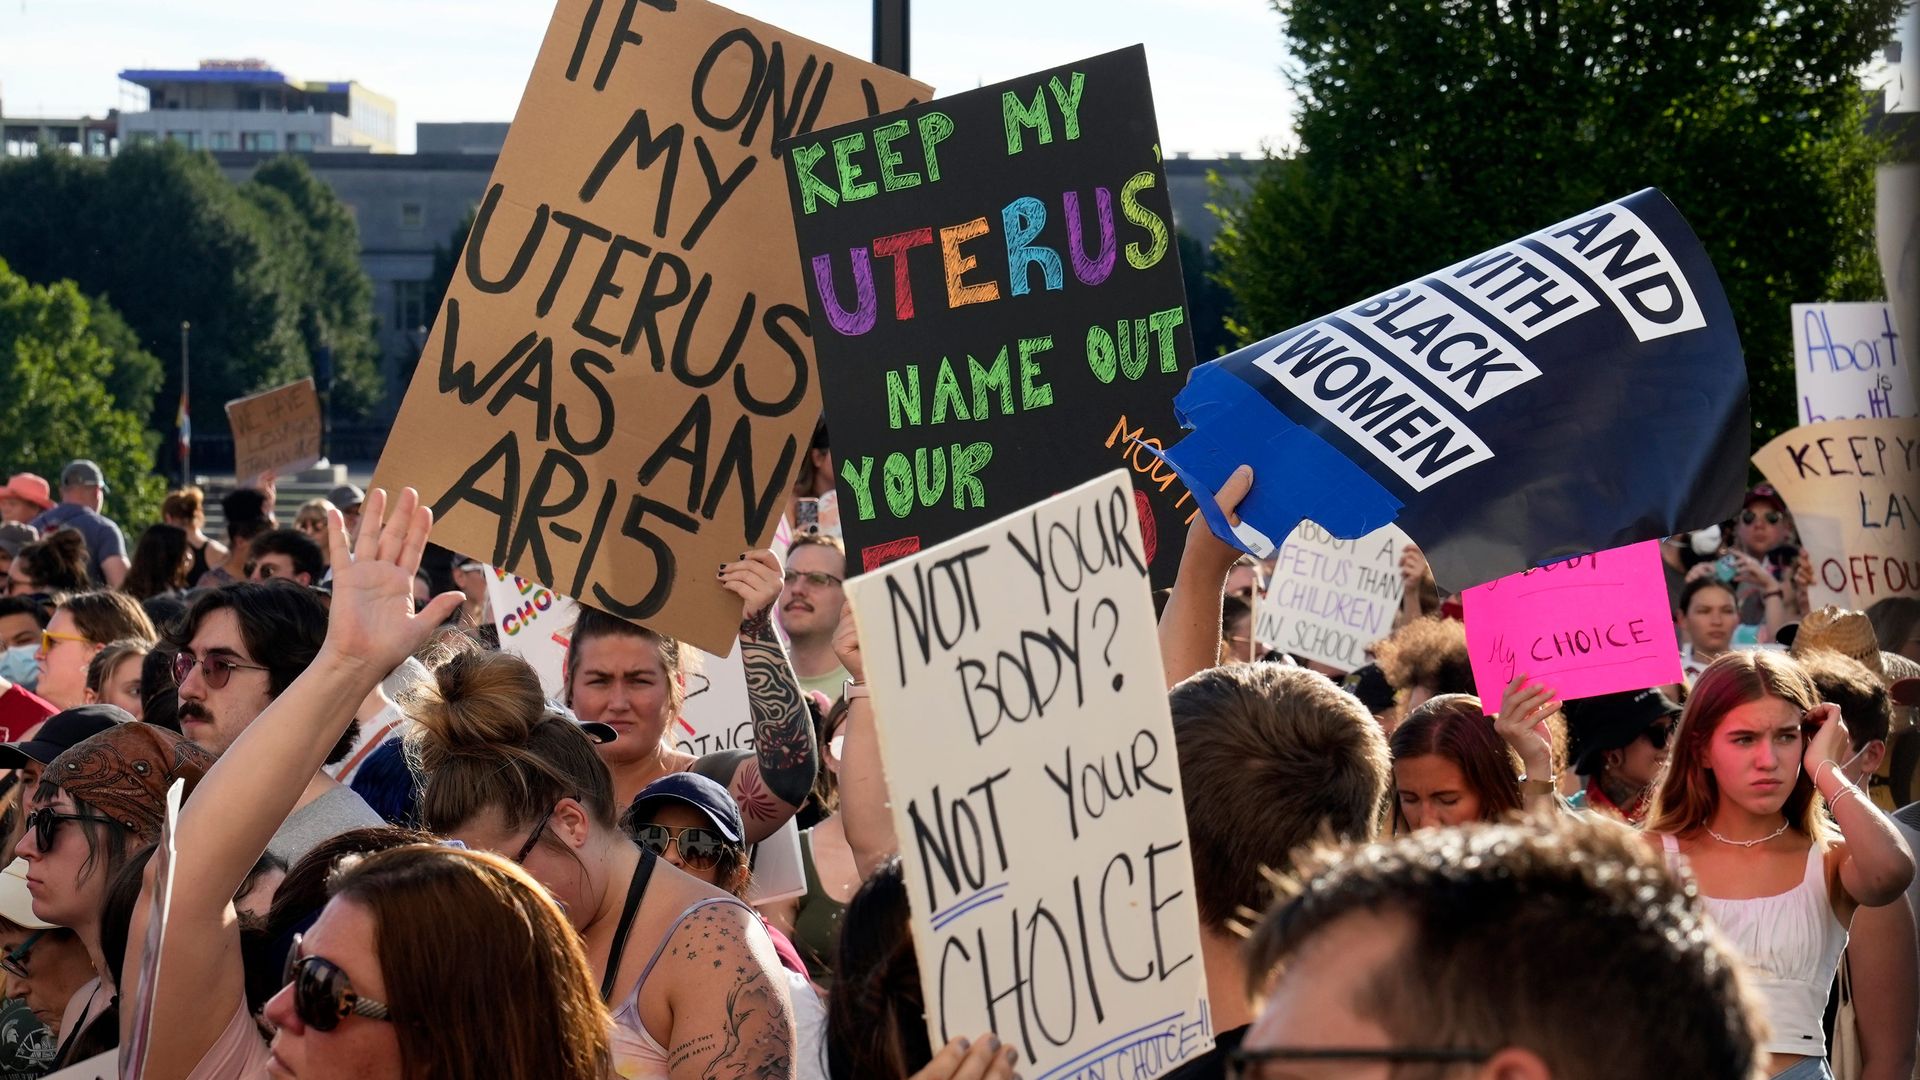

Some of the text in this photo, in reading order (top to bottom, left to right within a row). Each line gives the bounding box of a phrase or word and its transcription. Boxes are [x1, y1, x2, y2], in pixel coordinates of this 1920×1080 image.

[565, 0, 919, 159] IF ONL
[579, 108, 758, 250] MY
[792, 72, 1086, 215] KEEP MY
[465, 183, 812, 417] UTERUS
[1351, 287, 1522, 399] BLACK
[438, 297, 797, 548] WAS AN
[886, 305, 1184, 429] NAME OUT
[1273, 328, 1475, 479] WOMEN
[840, 441, 994, 521] YOUR
[1104, 414, 1200, 525] MOU
[1786, 436, 1886, 479] KEEP
[431, 430, 700, 619] AR-15
[885, 545, 990, 688] NOT
[1007, 485, 1147, 615] YOUR
[1279, 544, 1402, 601] FETUS THAN
[1376, 538, 1394, 567] A
[1821, 554, 1879, 596] OFF
[1256, 612, 1284, 641] IN
[1277, 579, 1384, 635] CHILDREN
[1530, 619, 1653, 662] CHOICE
[908, 729, 1174, 914] NOT YOUR
[940, 839, 1194, 1064] CHOICE
